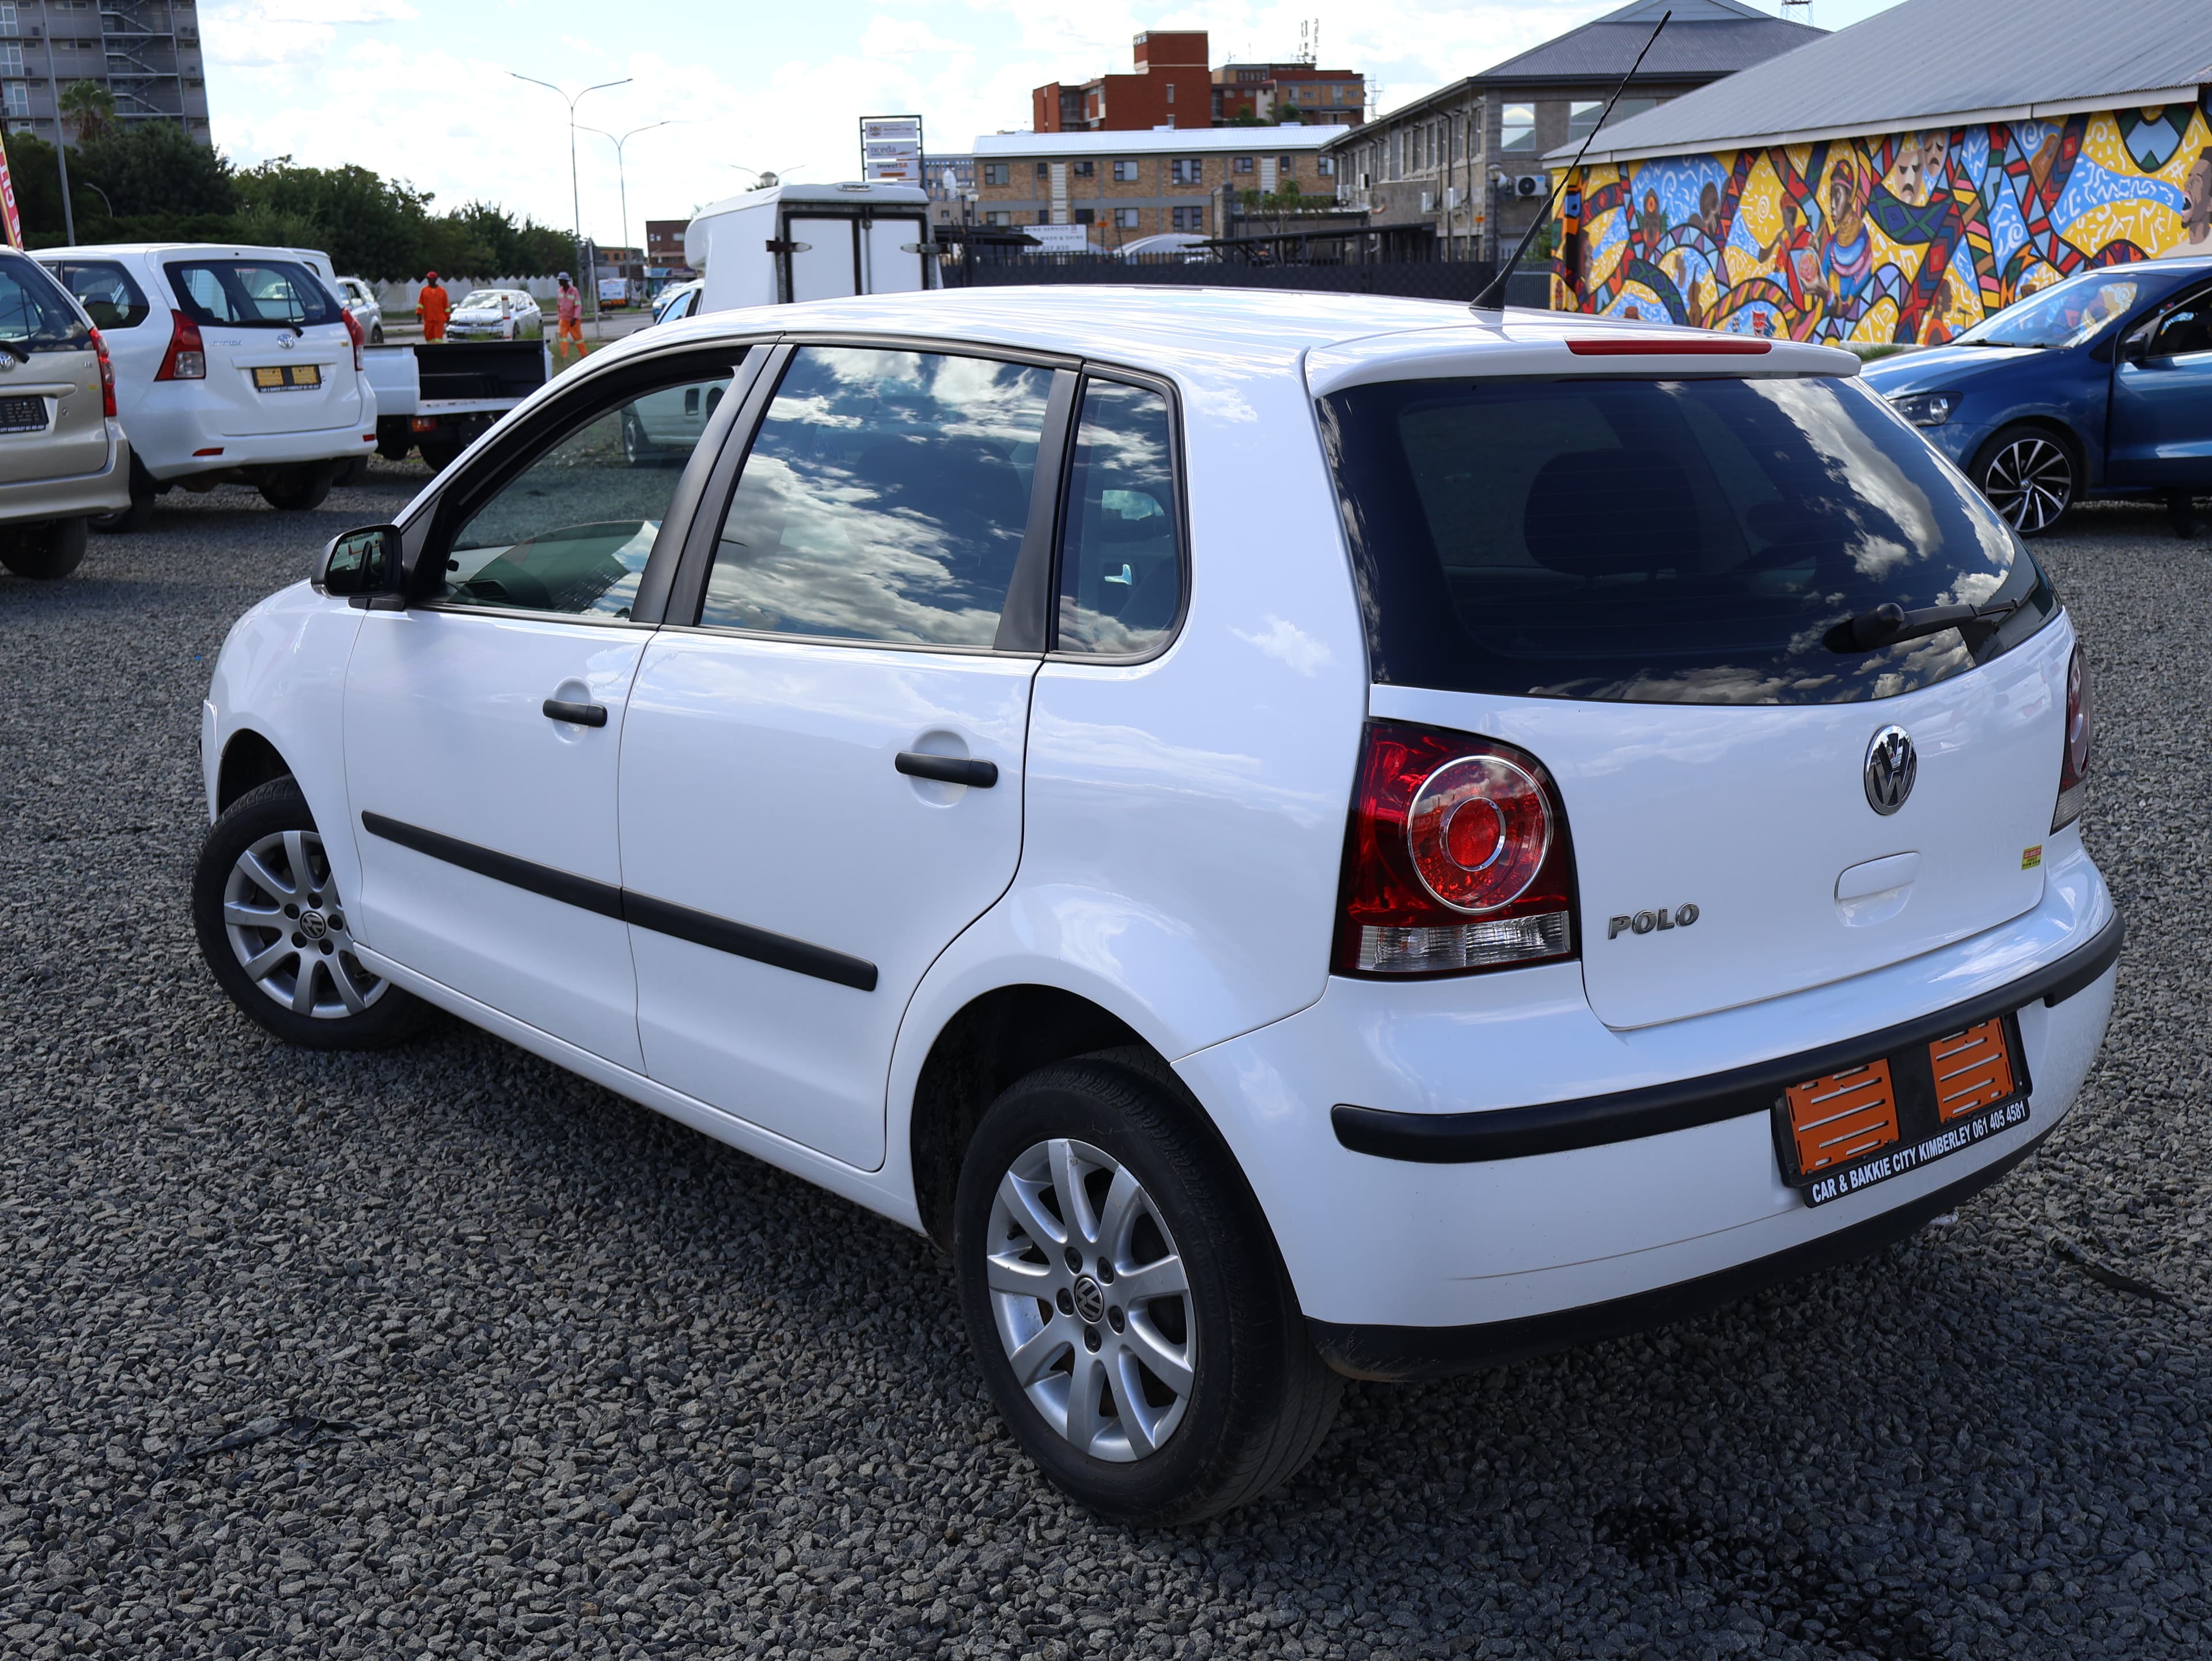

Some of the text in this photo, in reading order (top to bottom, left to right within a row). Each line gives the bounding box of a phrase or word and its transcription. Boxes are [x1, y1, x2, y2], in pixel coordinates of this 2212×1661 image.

[1608, 902, 1700, 940] POLO
[1812, 1099, 2026, 1203] CAR & BAKKIE CITY KIMBERLEY 061 405 4581
